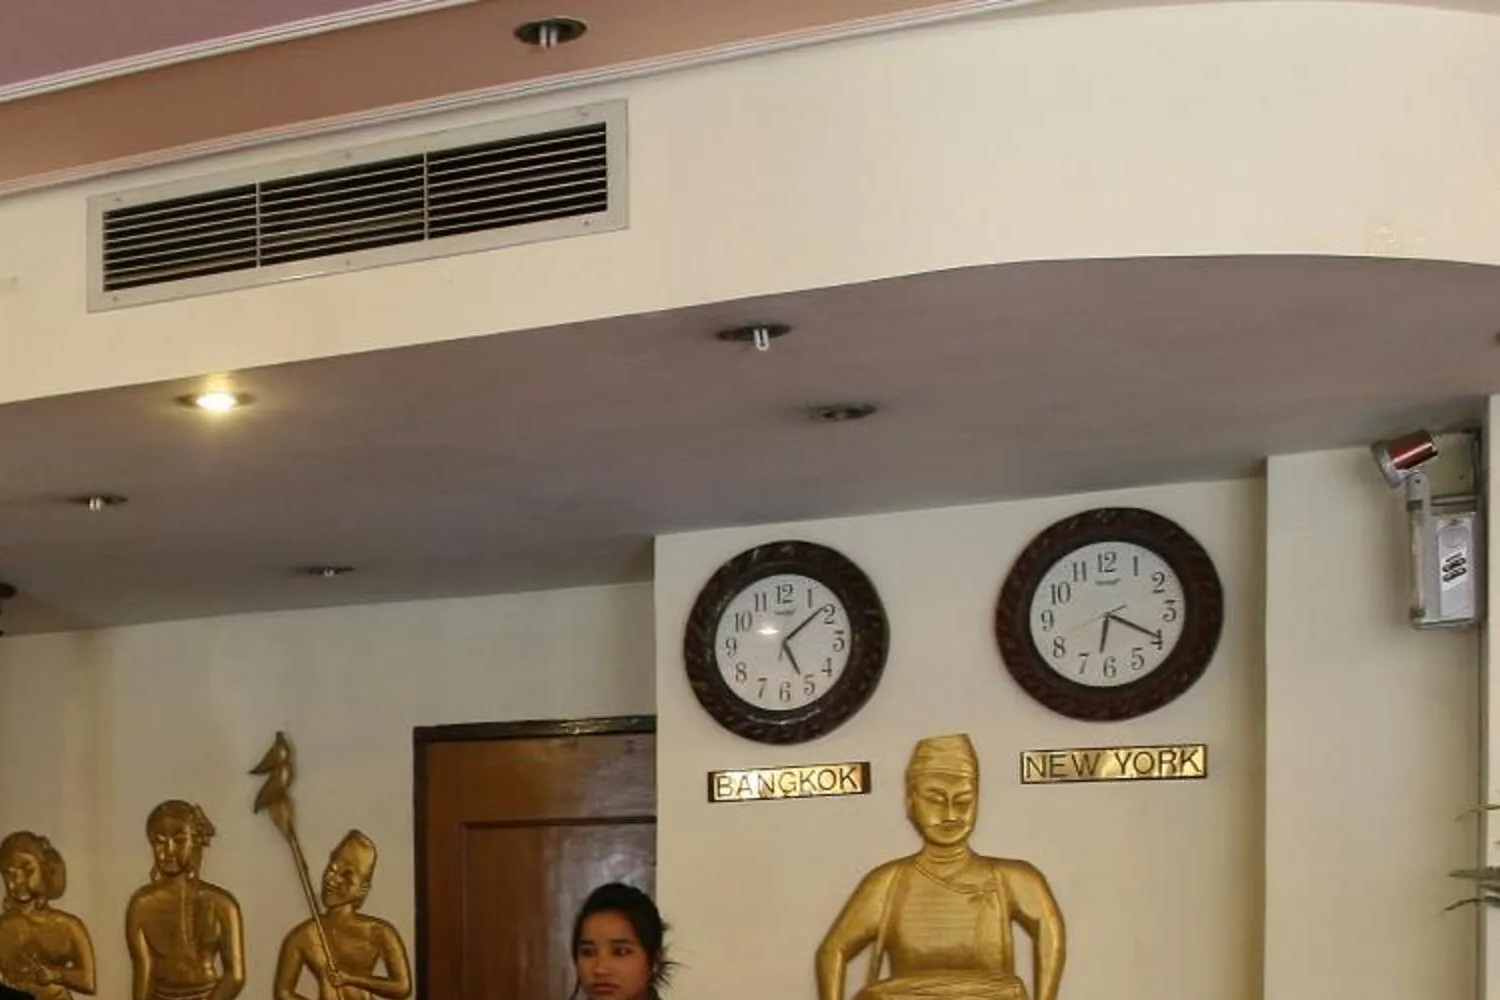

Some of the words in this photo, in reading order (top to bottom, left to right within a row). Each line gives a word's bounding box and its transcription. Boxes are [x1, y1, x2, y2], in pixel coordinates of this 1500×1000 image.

[1073, 561, 1087, 582] 11
[1097, 551, 1117, 573] 12
[1133, 555, 1139, 577] 1
[1051, 581, 1071, 605] 10
[1151, 571, 1165, 594] 2
[754, 592, 767, 612] 11
[777, 584, 793, 604] 12
[807, 588, 813, 608] 1
[735, 611, 753, 632] 10
[823, 603, 836, 625] 2
[1041, 609, 1054, 632] 9
[1162, 599, 1177, 622] 3
[725, 637, 737, 657] 9
[832, 630, 845, 652] 3
[1052, 636, 1066, 658] 8
[821, 658, 833, 678] 4
[1078, 653, 1090, 674] 7
[1103, 656, 1117, 678] 6
[1131, 647, 1145, 670] 5
[735, 662, 747, 683] 8
[757, 677, 767, 698] 7
[779, 682, 791, 702] 6
[803, 673, 816, 695] 5
[1025, 751, 1100, 779] NEW
[1114, 748, 1202, 776] YORK
[716, 767, 858, 798] BANGKOK
